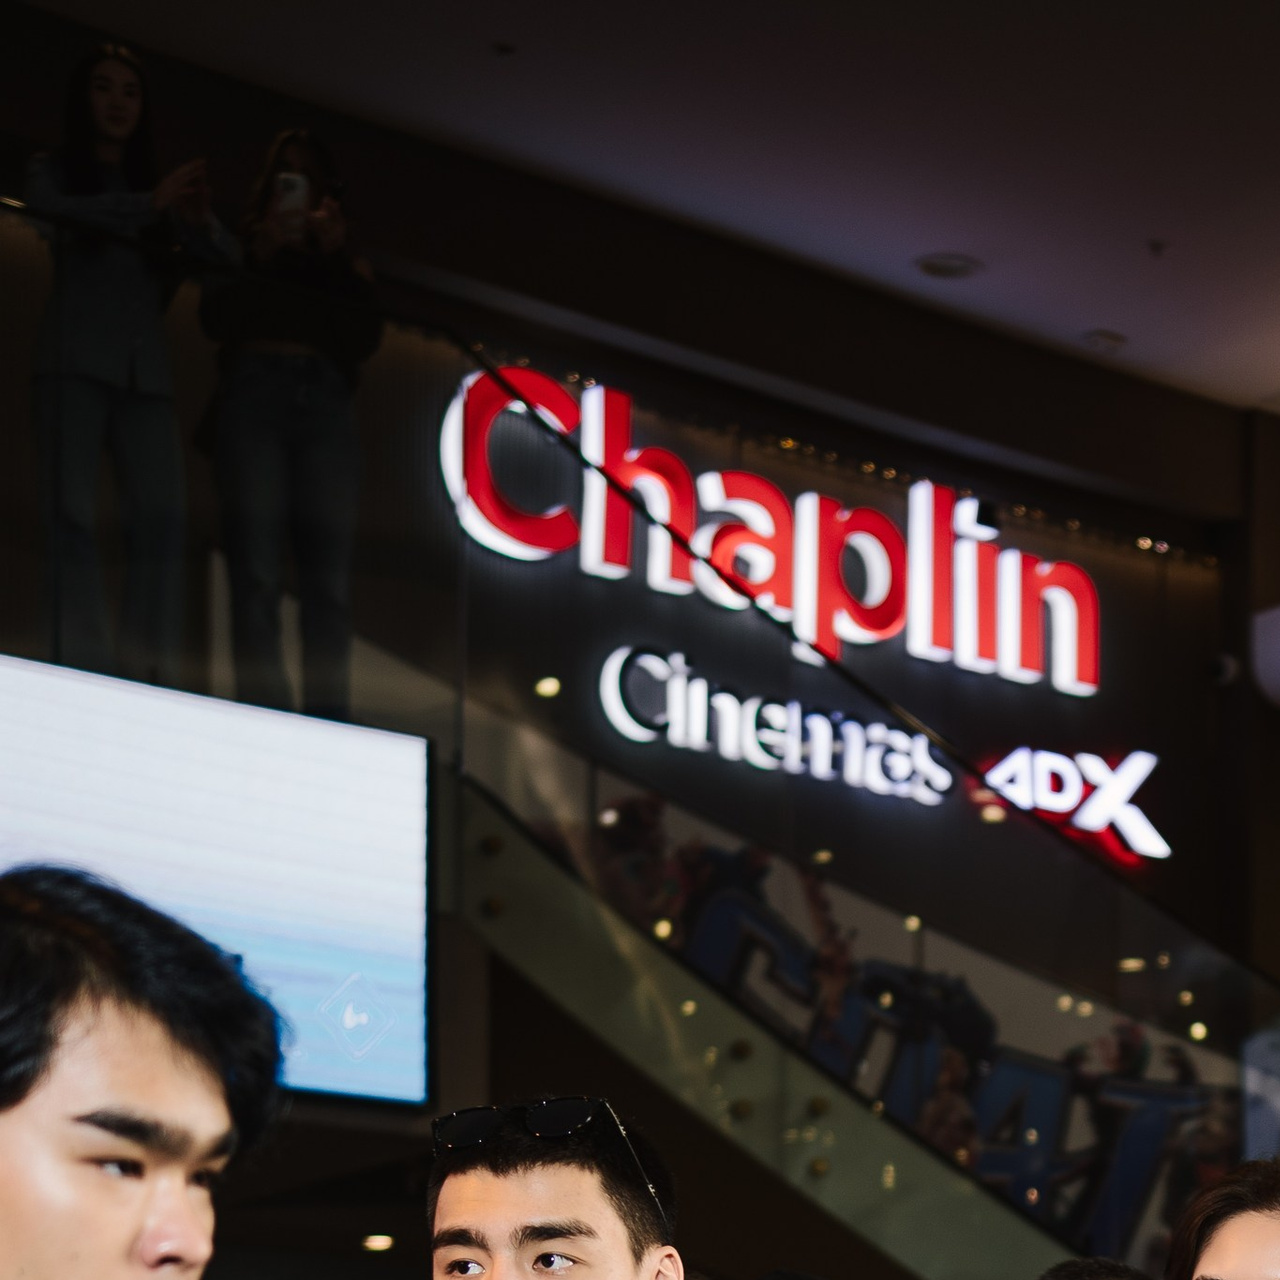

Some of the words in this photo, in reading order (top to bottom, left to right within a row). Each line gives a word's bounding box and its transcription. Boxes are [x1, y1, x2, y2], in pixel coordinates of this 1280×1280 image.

[440, 366, 1102, 696] Chaplin
[598, 643, 954, 806] Cinemas
[983, 745, 1172, 859] 4DX
